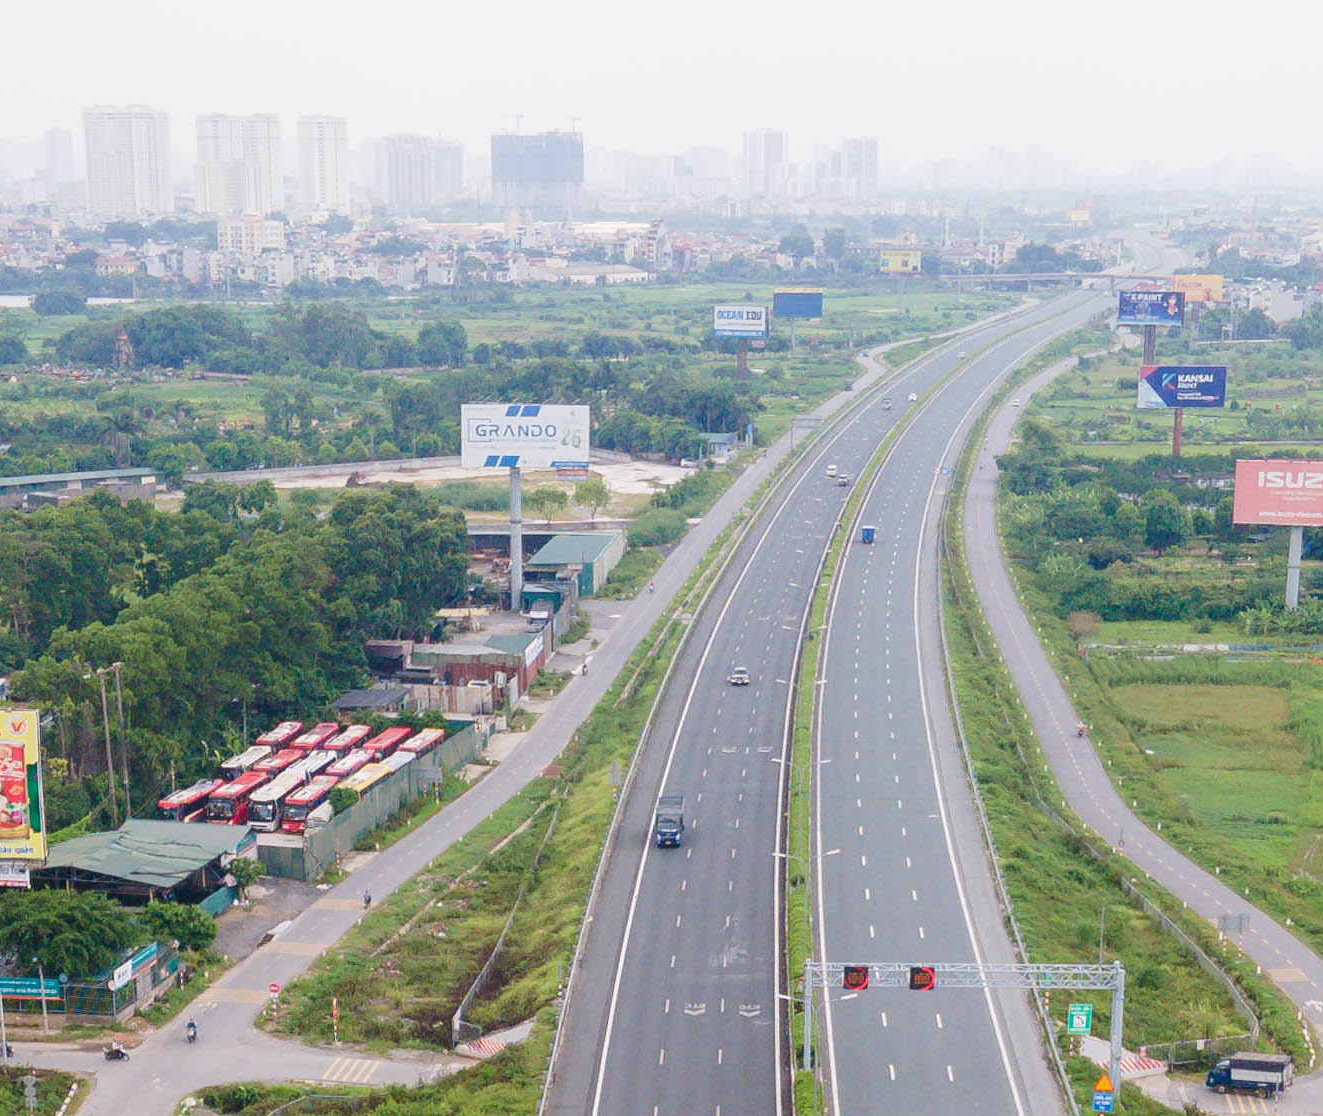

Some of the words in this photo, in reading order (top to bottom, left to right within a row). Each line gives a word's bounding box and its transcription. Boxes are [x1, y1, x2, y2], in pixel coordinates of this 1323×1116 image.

[716, 310, 744, 320] OCEAN
[746, 310, 763, 321] EDU
[1177, 374, 1214, 383] KANSAI
[475, 424, 557, 438] GRANDO
